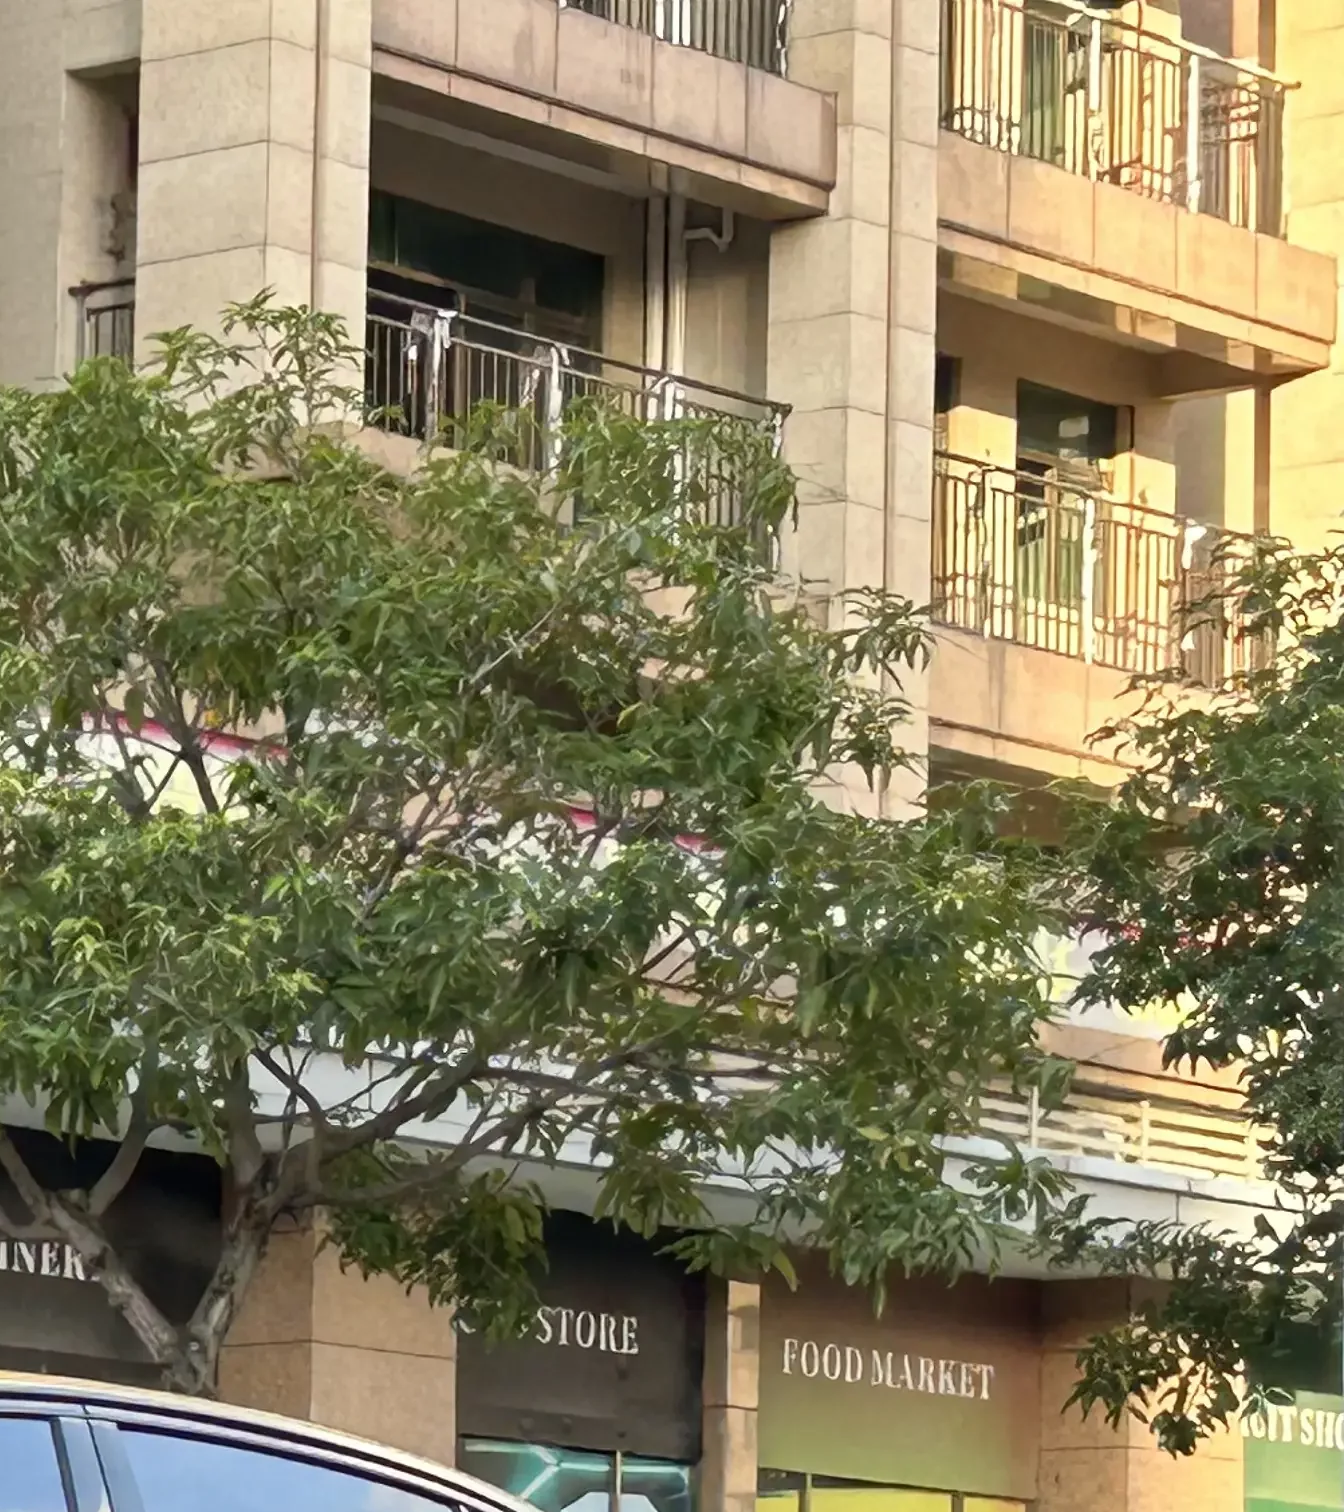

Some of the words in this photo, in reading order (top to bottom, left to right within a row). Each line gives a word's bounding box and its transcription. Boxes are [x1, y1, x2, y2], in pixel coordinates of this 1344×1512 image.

[534, 1305, 640, 1355] STORE
[782, 1338, 863, 1383] FOOD
[870, 1349, 995, 1400] MARKET
